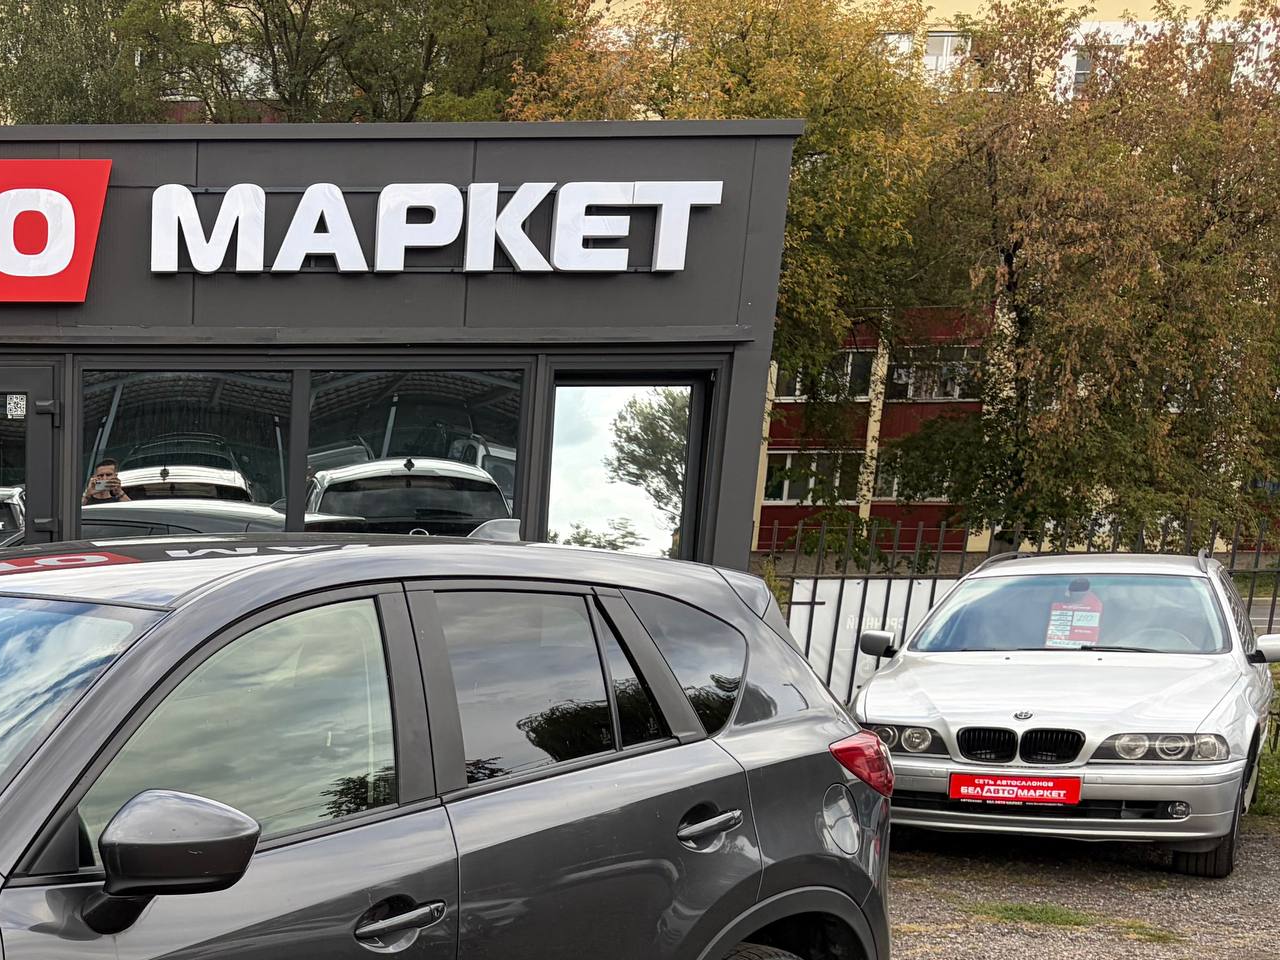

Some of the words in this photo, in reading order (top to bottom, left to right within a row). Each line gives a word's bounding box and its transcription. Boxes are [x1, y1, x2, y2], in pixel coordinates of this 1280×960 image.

[150, 180, 724, 273] МАРКЕТ
[996, 779, 1054, 787] АВТОСАЛОНОВ
[960, 786, 982, 795] БЕЛ
[984, 787, 1016, 797] АВТО
[1017, 789, 1067, 798] МАРКЕТ
